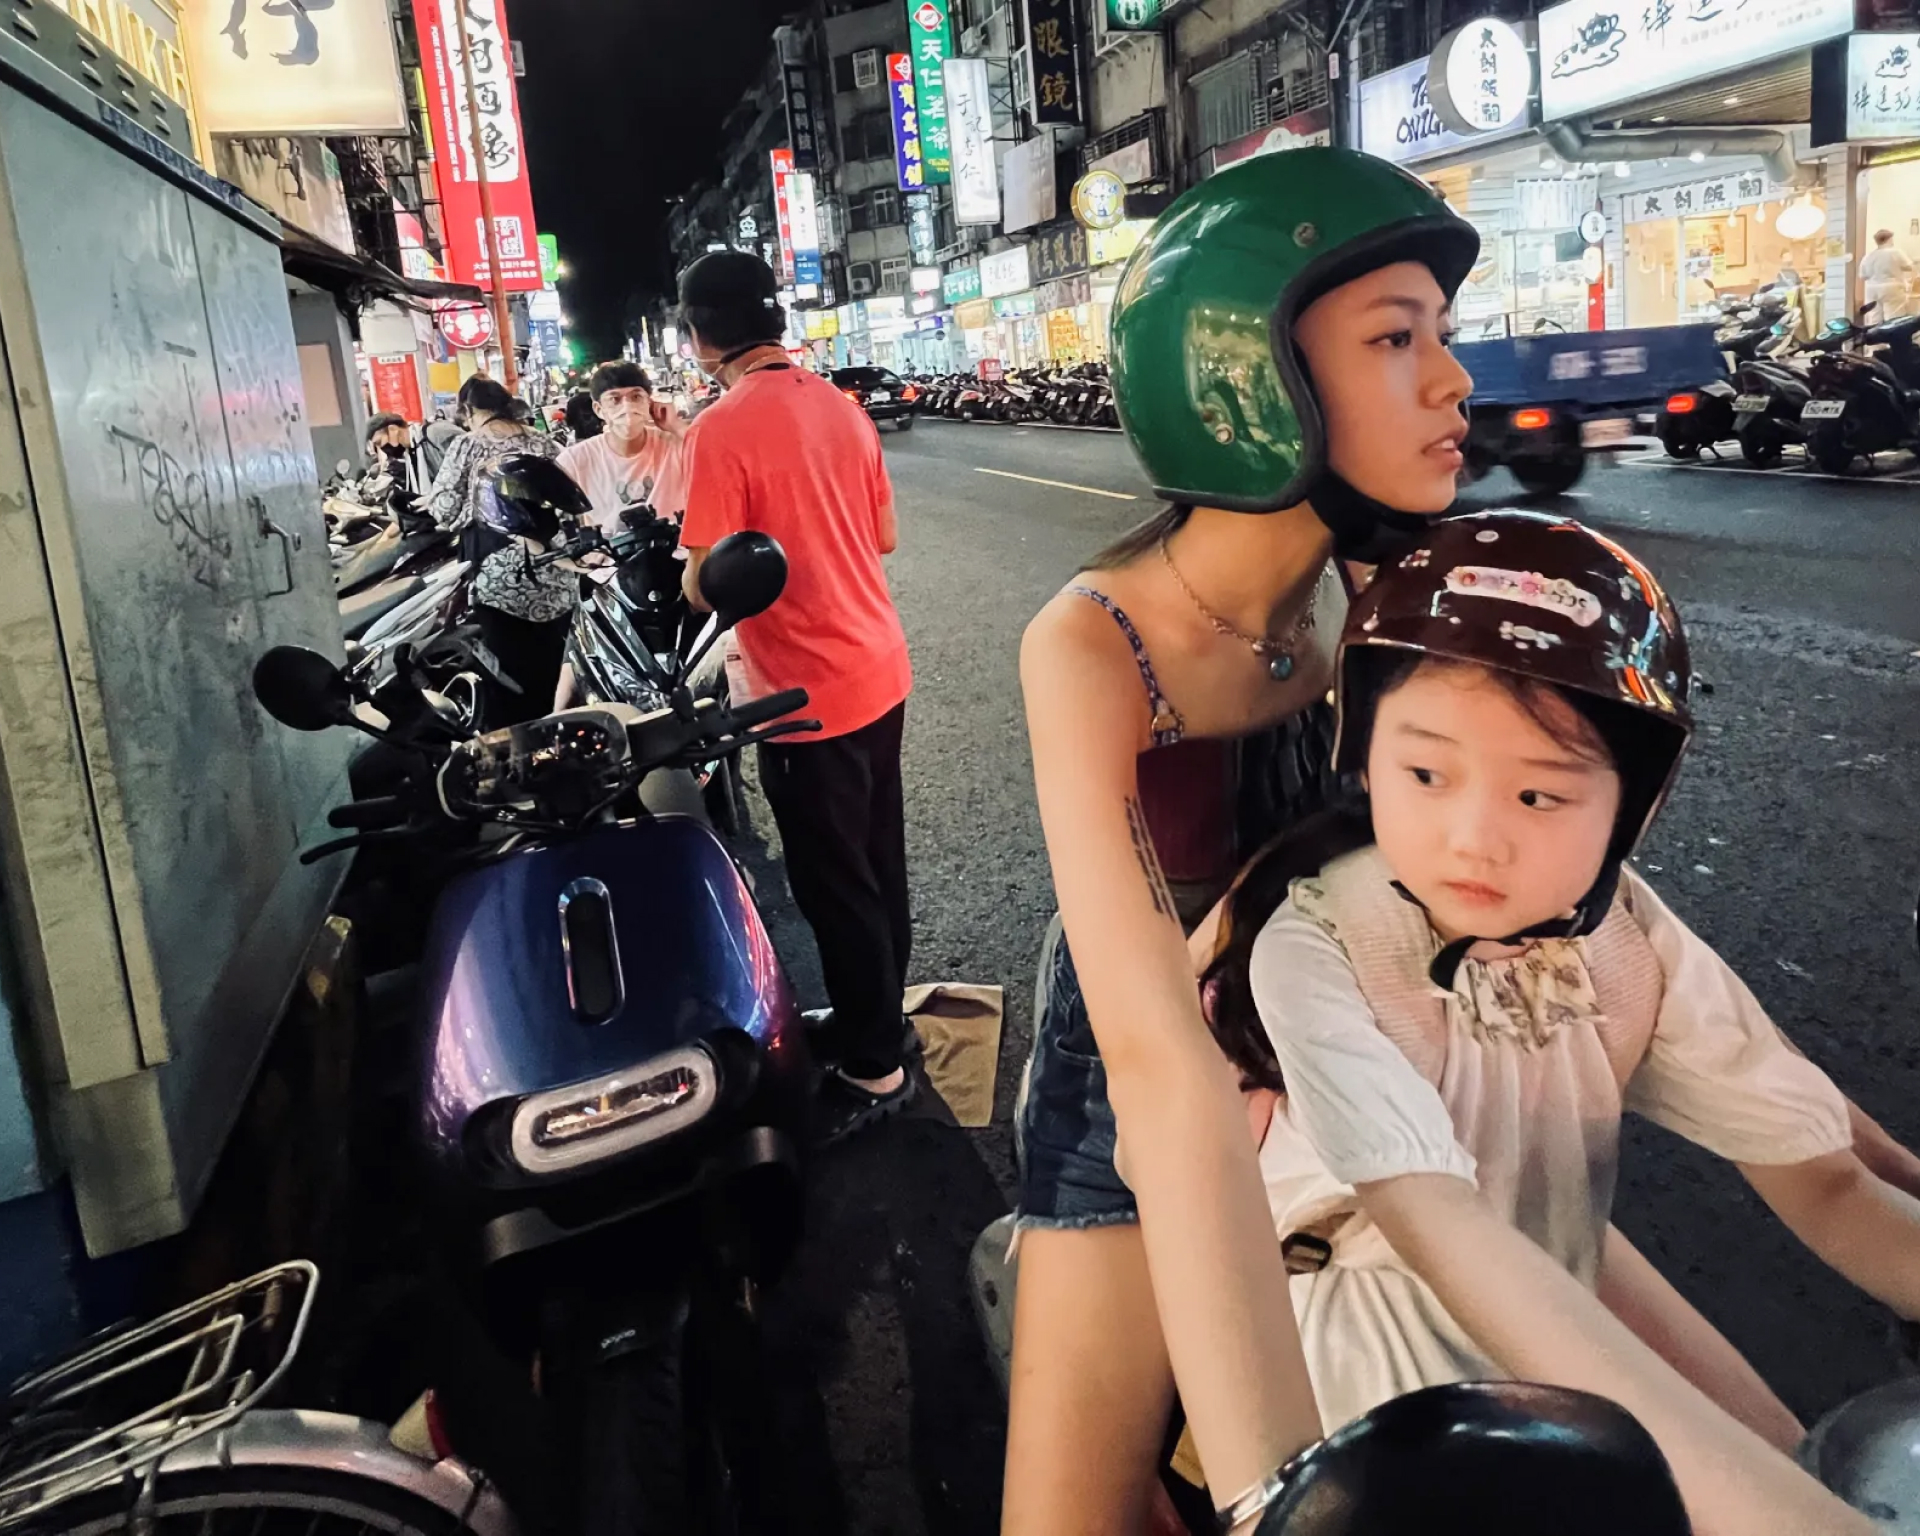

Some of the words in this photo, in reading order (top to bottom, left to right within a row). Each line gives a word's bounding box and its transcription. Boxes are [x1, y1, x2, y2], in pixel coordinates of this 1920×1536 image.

[1033, 0, 1073, 111] 眼鏡
[1639, 0, 1747, 50] 樺達
[919, 39, 949, 150] 天仁茗茶
